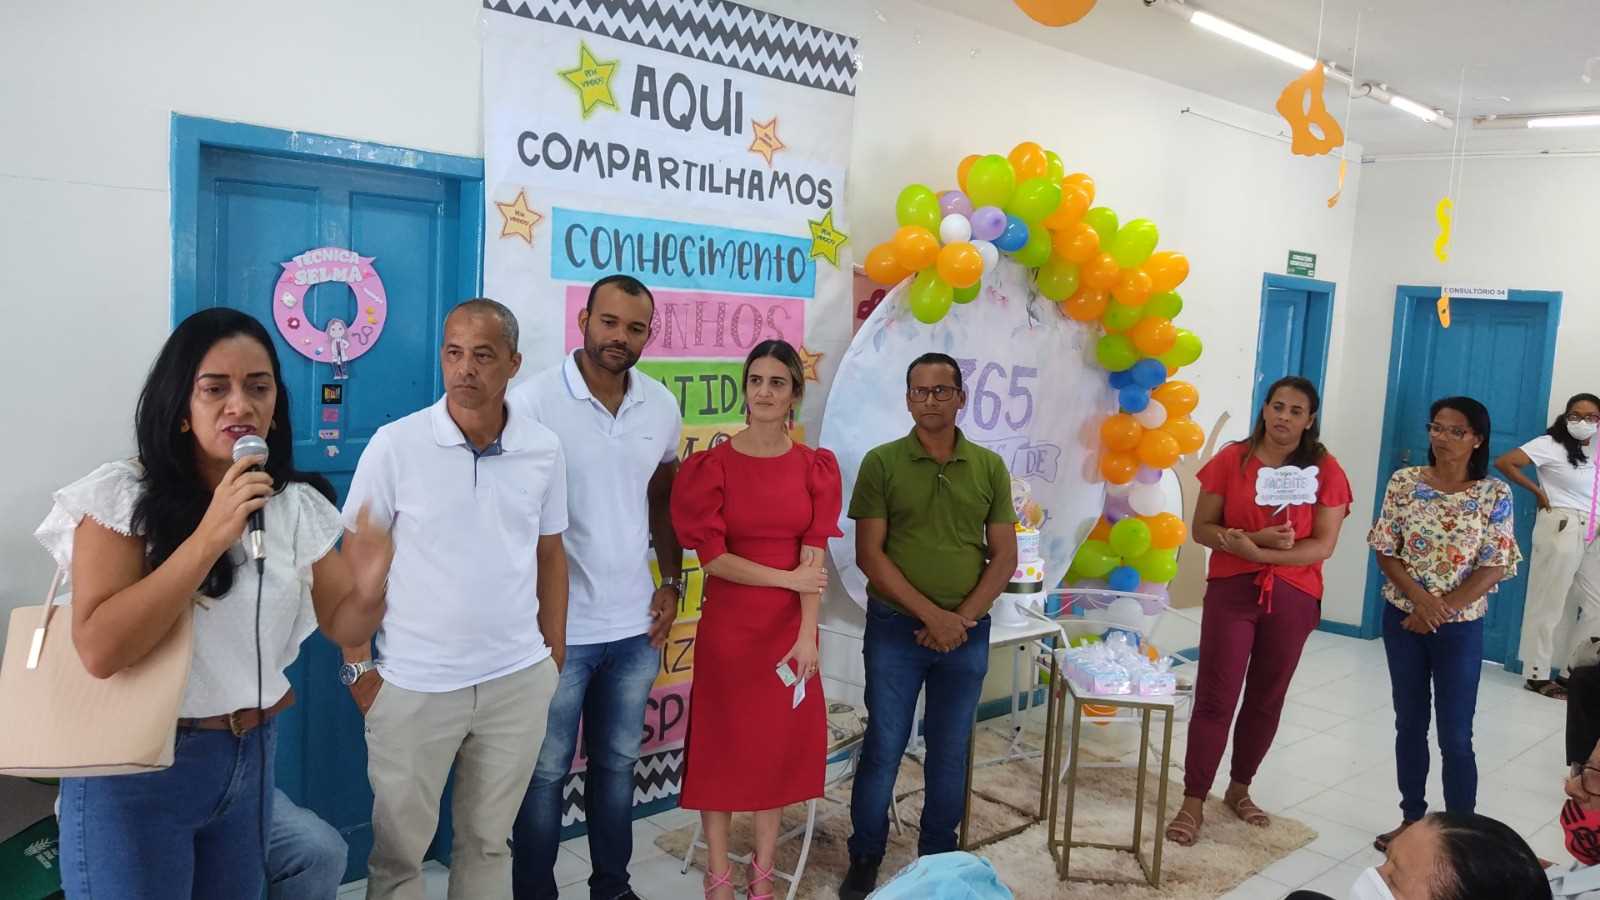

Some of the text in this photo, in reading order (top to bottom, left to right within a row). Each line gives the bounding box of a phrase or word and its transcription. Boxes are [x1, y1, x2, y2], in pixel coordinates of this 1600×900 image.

[630, 64, 743, 136] AQUI
[517, 131, 833, 210] COMPARTILHAMOS
[294, 265, 362, 285] SELMA
[662, 374, 747, 418] TID
[1026, 449, 1048, 474] DE
